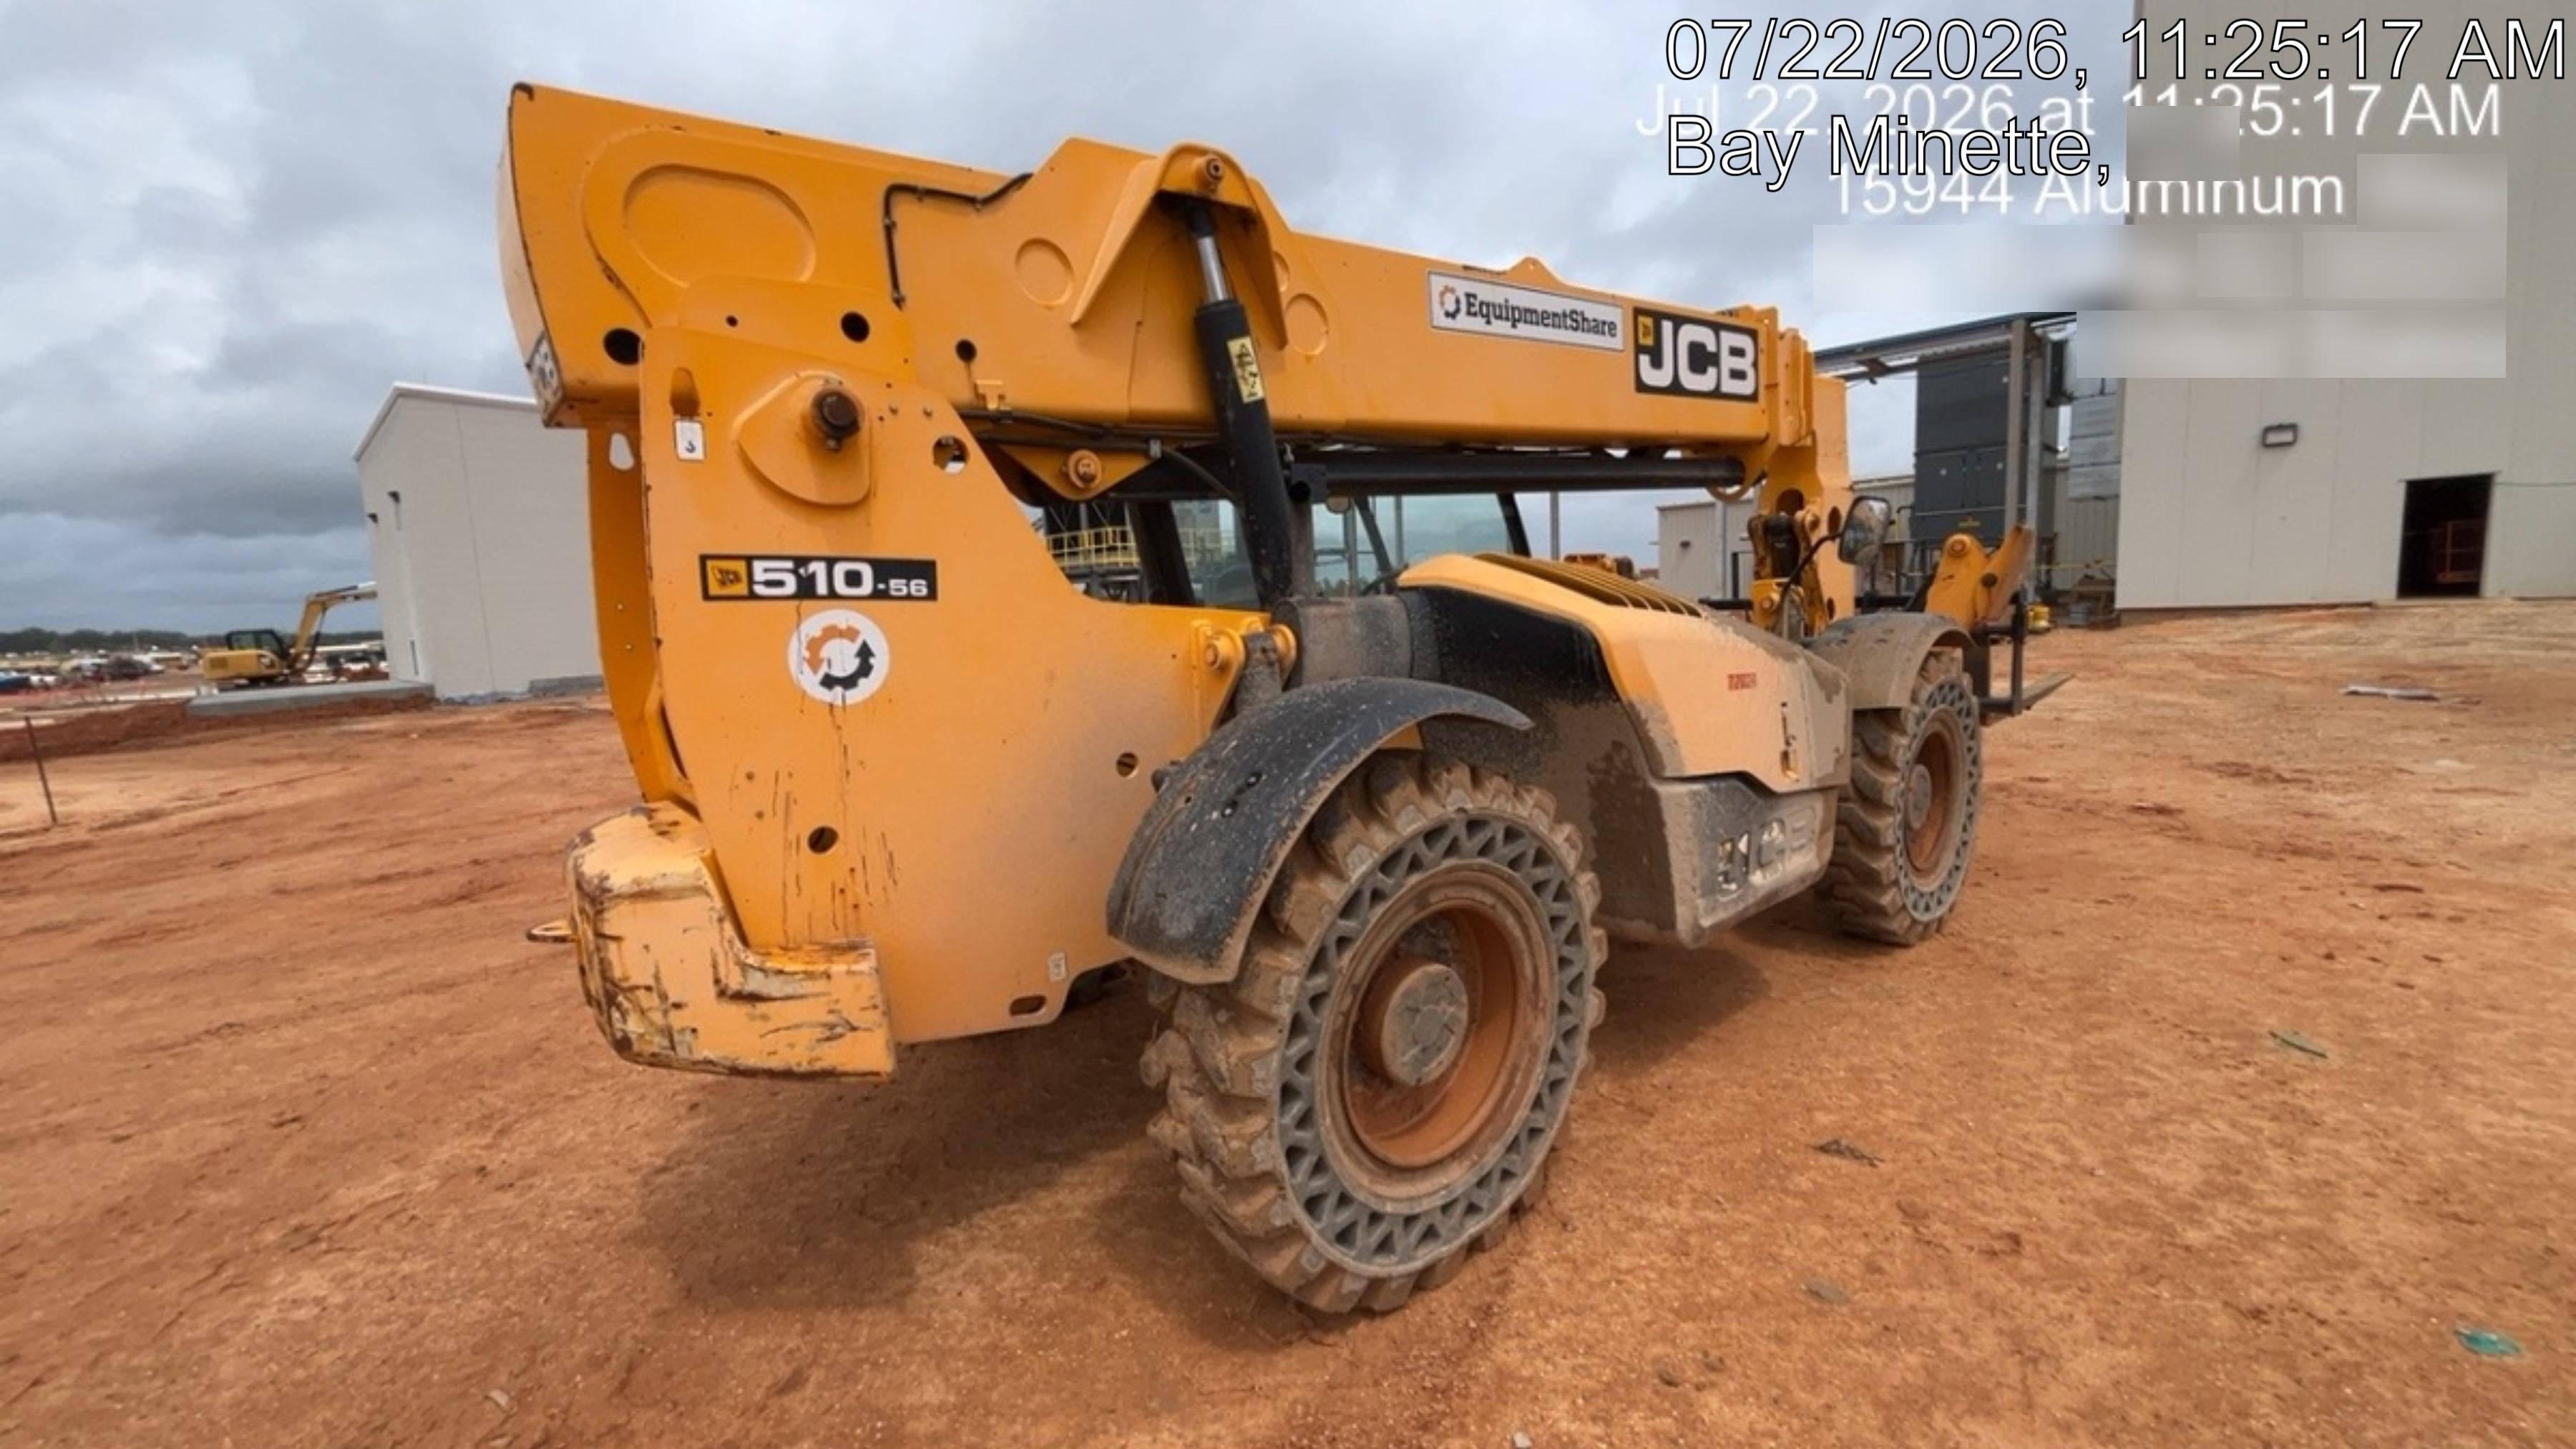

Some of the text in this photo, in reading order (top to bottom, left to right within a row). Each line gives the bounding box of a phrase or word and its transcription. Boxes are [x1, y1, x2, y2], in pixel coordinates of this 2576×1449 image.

[1464, 291, 1618, 338] EquipmentShare
[1638, 319, 1757, 396] JCB
[751, 560, 929, 597] 510-56
